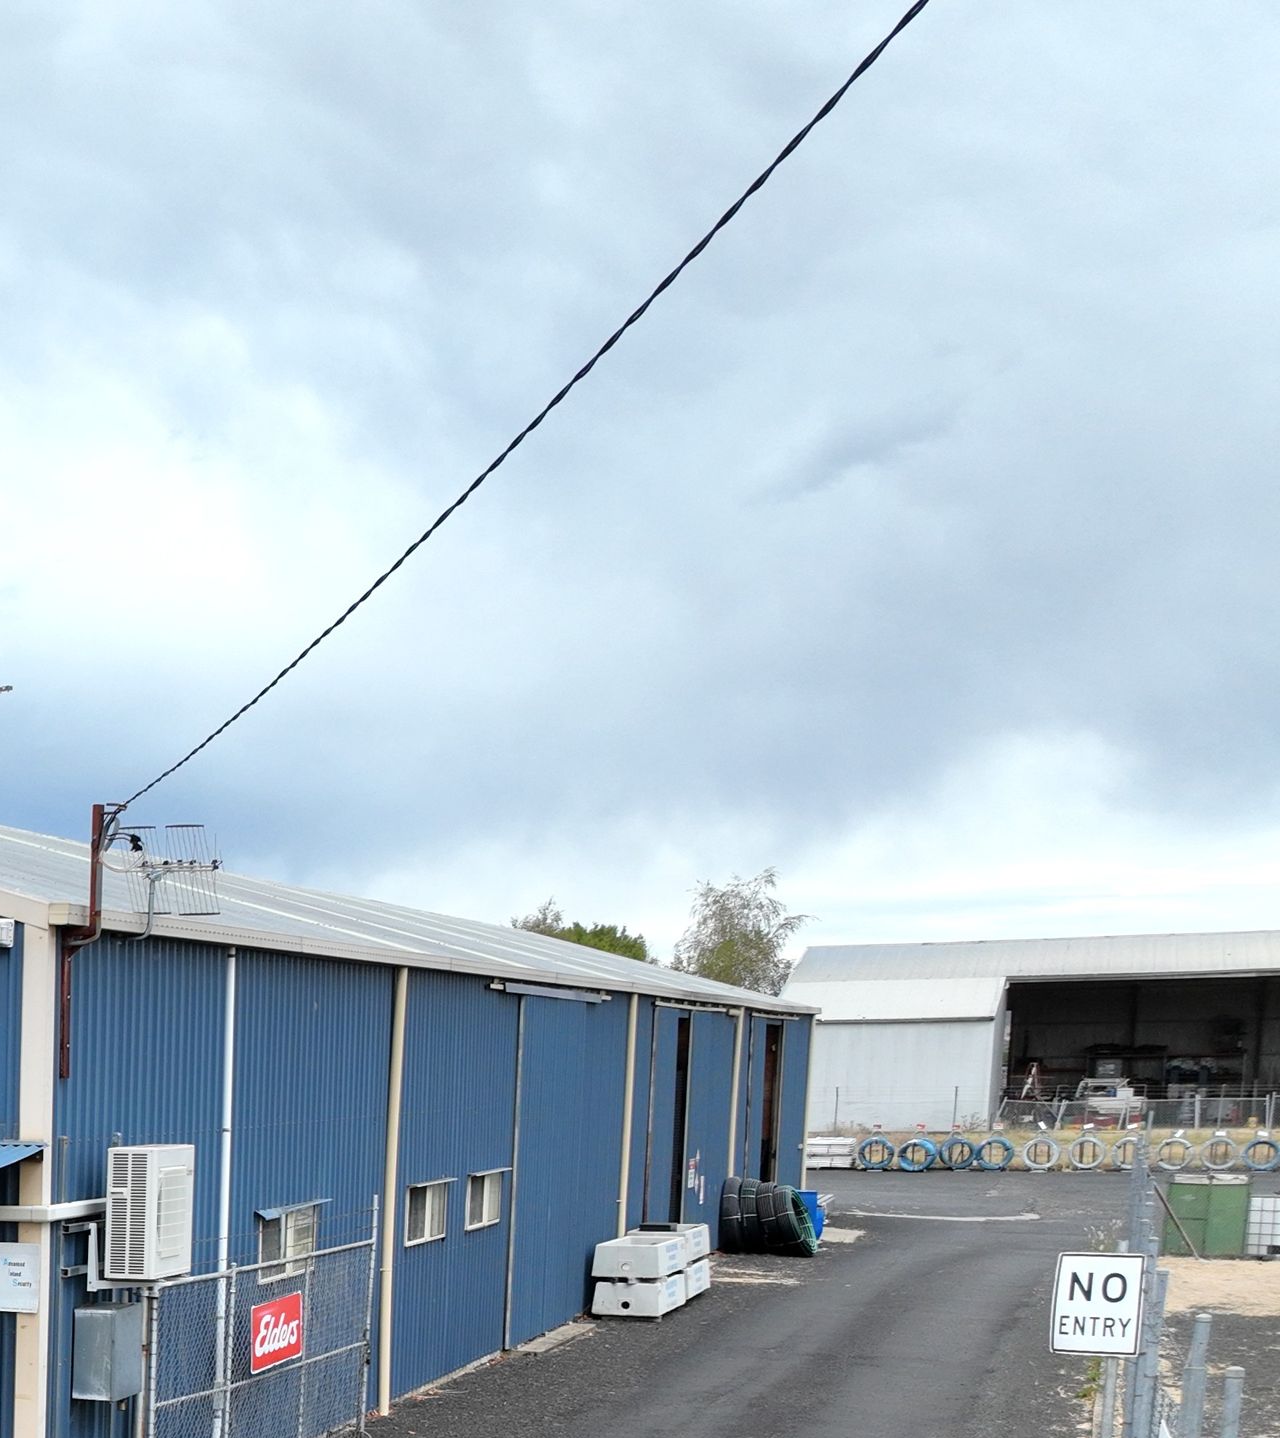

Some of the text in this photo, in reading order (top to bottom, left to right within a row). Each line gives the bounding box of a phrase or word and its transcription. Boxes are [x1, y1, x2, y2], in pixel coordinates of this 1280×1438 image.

[1068, 1271, 1128, 1303] NO
[254, 1312, 300, 1358] Elders
[1058, 1315, 1132, 1338] ENTRY
